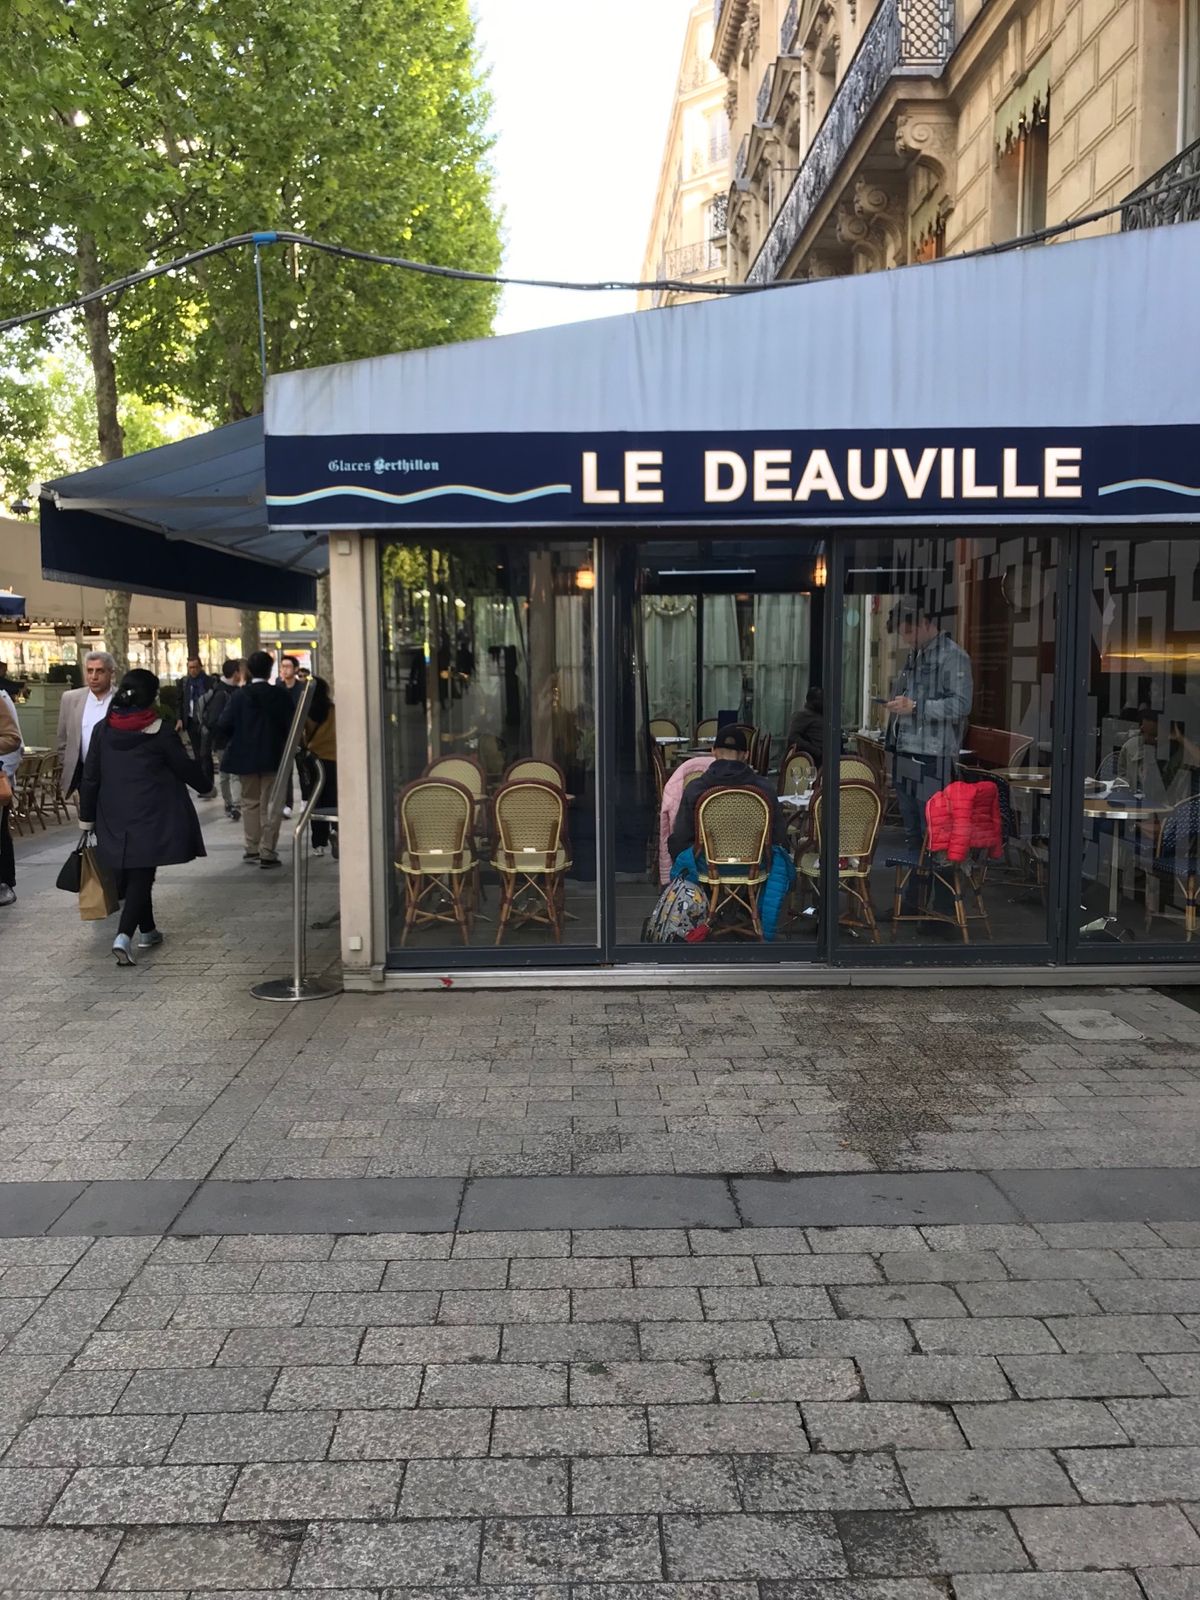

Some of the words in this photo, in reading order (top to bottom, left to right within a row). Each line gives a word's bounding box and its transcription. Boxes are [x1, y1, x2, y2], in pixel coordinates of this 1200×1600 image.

[327, 459, 371, 472] Glaces
[373, 457, 440, 475] Berthillon
[582, 450, 664, 504] LE
[704, 447, 1083, 503] DEAUVILLE
